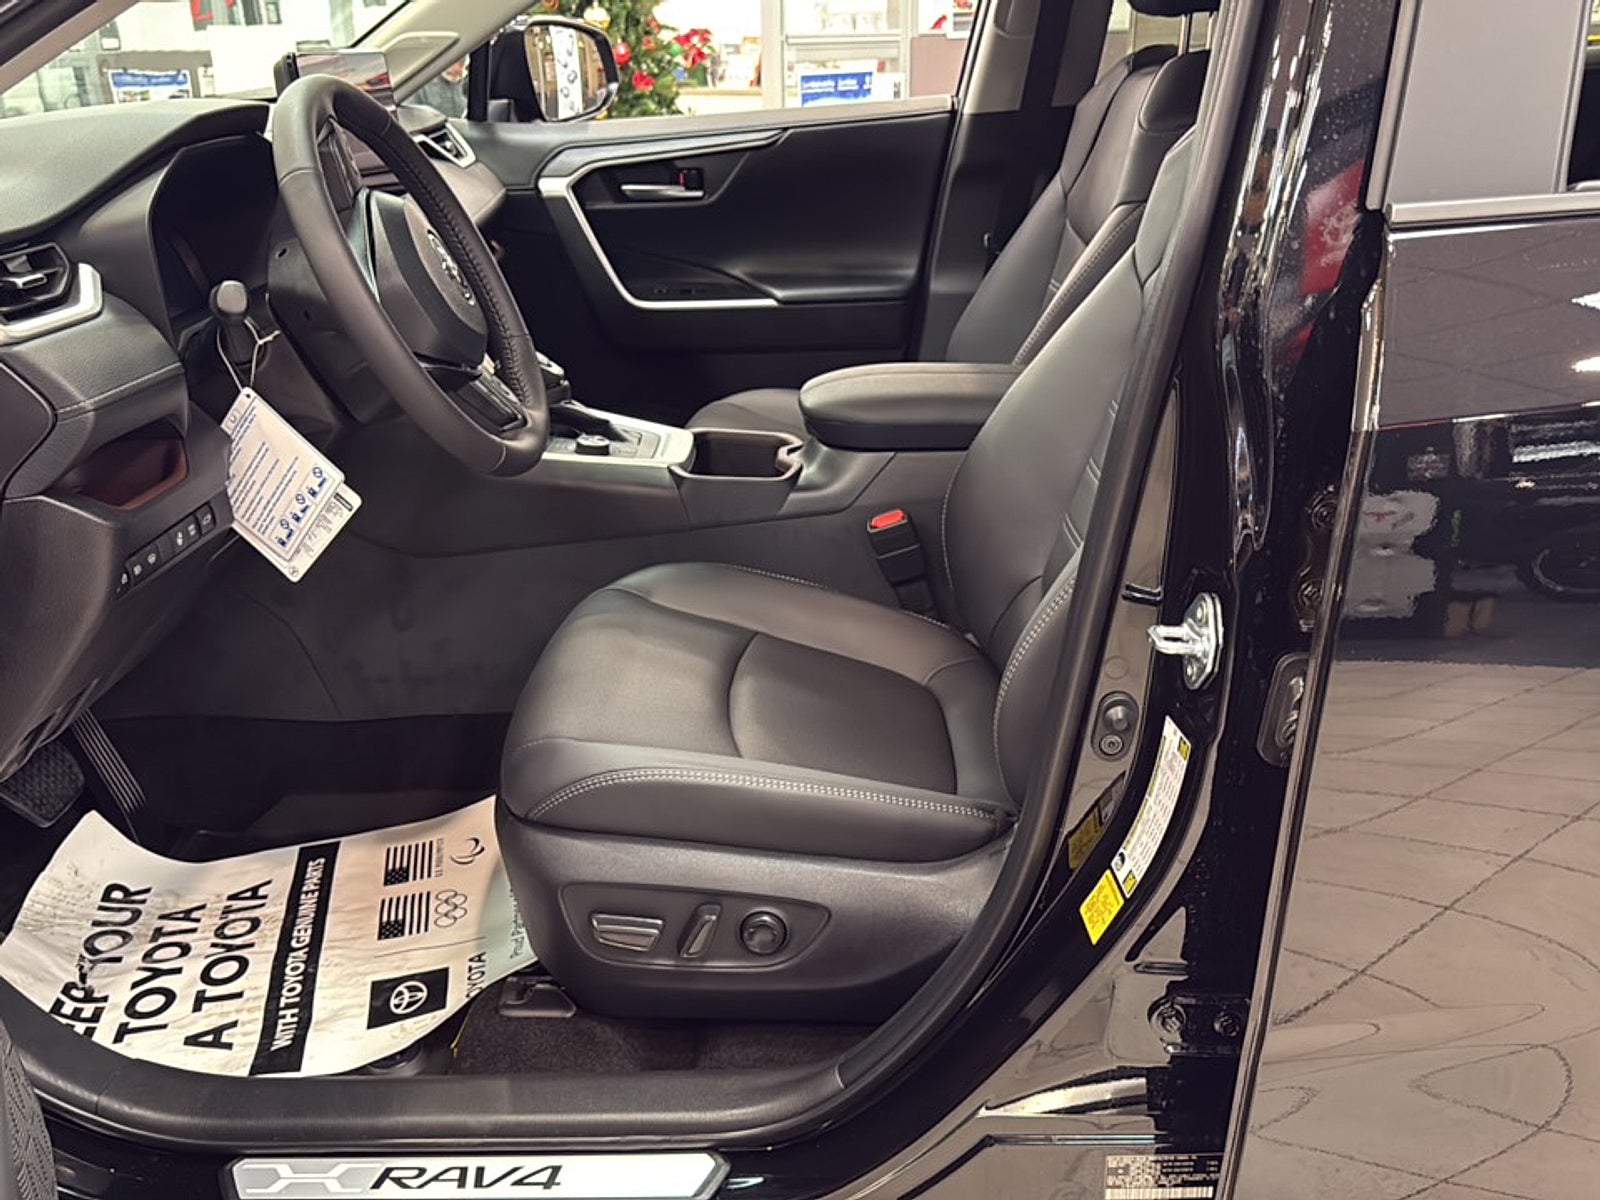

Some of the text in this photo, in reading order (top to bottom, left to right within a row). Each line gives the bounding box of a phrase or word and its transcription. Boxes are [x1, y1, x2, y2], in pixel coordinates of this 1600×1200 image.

[77, 883, 152, 984] YOUR
[112, 903, 207, 1044] TOYOTA
[183, 879, 273, 1050] A TOYOTA
[270, 857, 326, 1051] WITH TOYOTA GENUINE PARTS
[370, 1165, 562, 1190] RAV4
